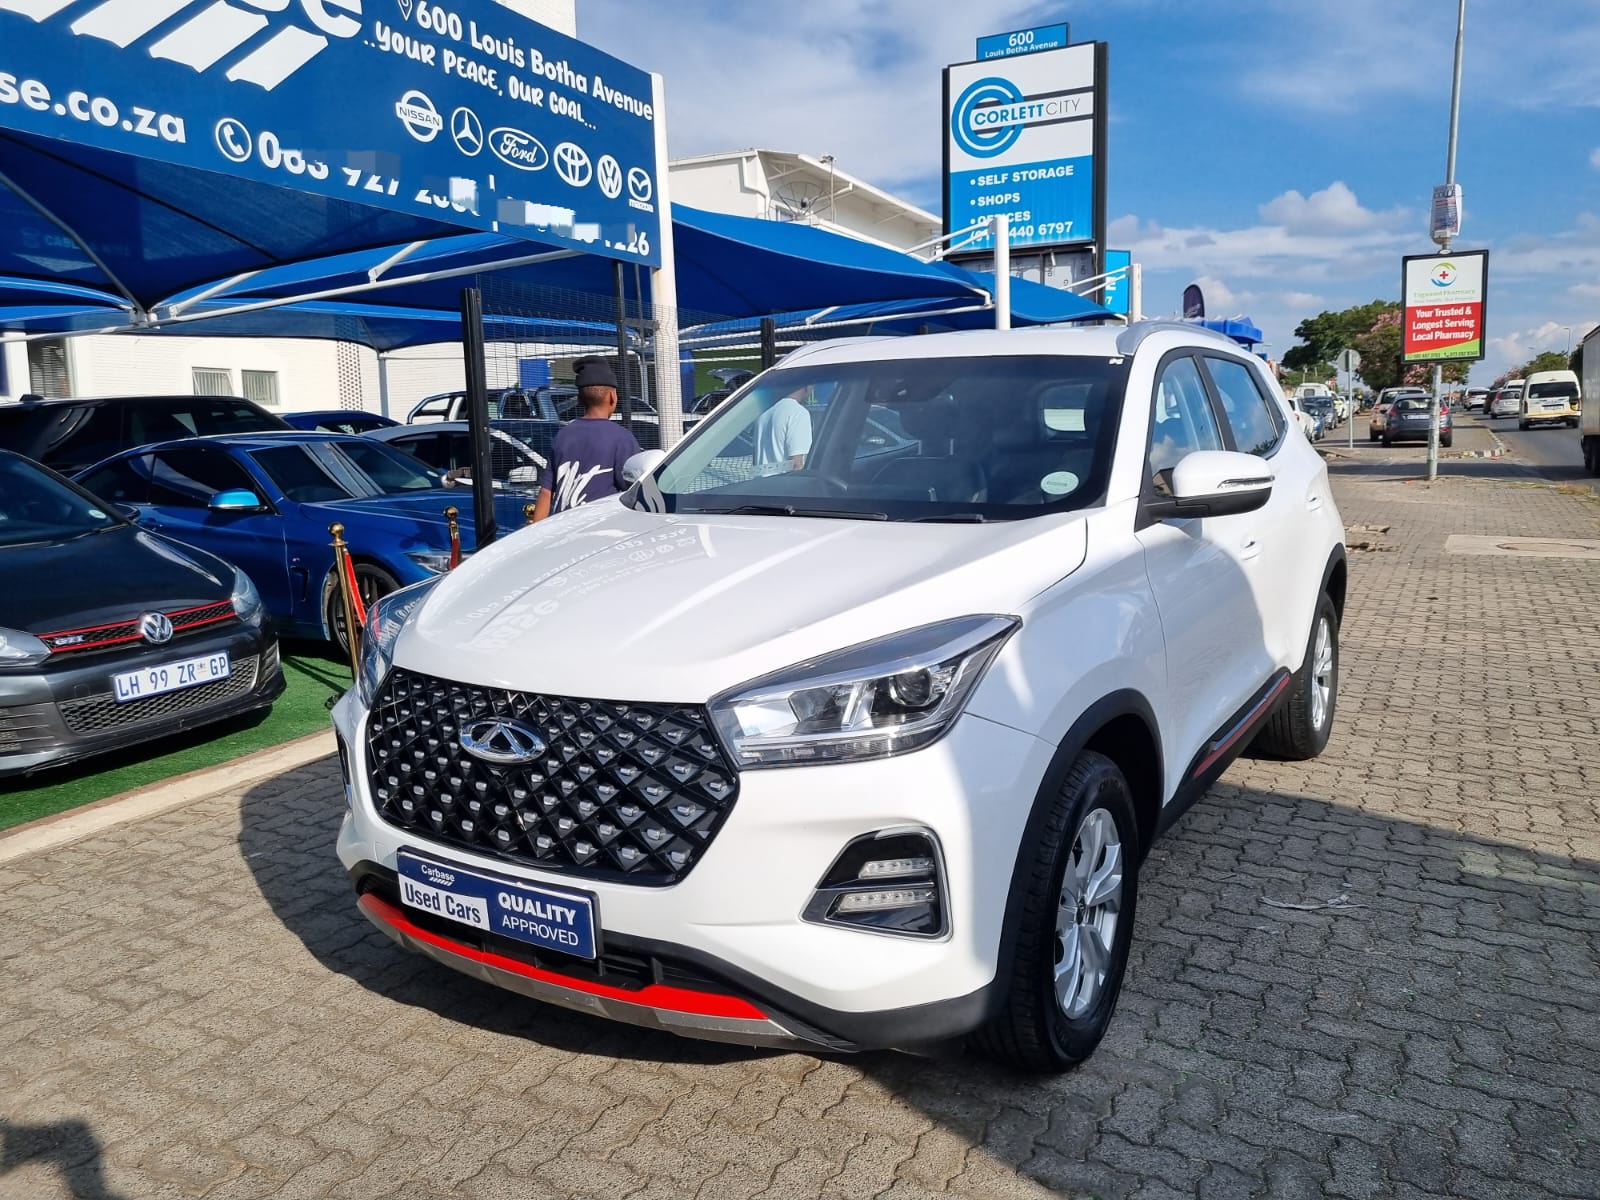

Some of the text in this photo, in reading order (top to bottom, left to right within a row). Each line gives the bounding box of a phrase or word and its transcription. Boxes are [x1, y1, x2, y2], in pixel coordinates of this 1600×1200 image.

[1009, 31, 1034, 46] 600
[985, 41, 1058, 58] Louis Botha Avenue
[416, 1, 653, 121] 600 Louis Botha Avenue
[399, 106, 440, 126] NISSAN
[500, 133, 537, 163] Ford
[977, 165, 1074, 187] SELF STORAGE
[977, 192, 1021, 207] SHOPS
[1038, 221, 1073, 236] 6797
[1416, 306, 1472, 318] Your Trusted &
[1412, 318, 1475, 331] Longest Serving
[1412, 330, 1474, 341] Local Pharmacy
[118, 655, 227, 697] LH 99 ZR GP
[421, 864, 456, 882] Carbase
[404, 882, 481, 924] Used Cars
[498, 892, 576, 926] QUALITY
[502, 914, 579, 946] APPROVED
